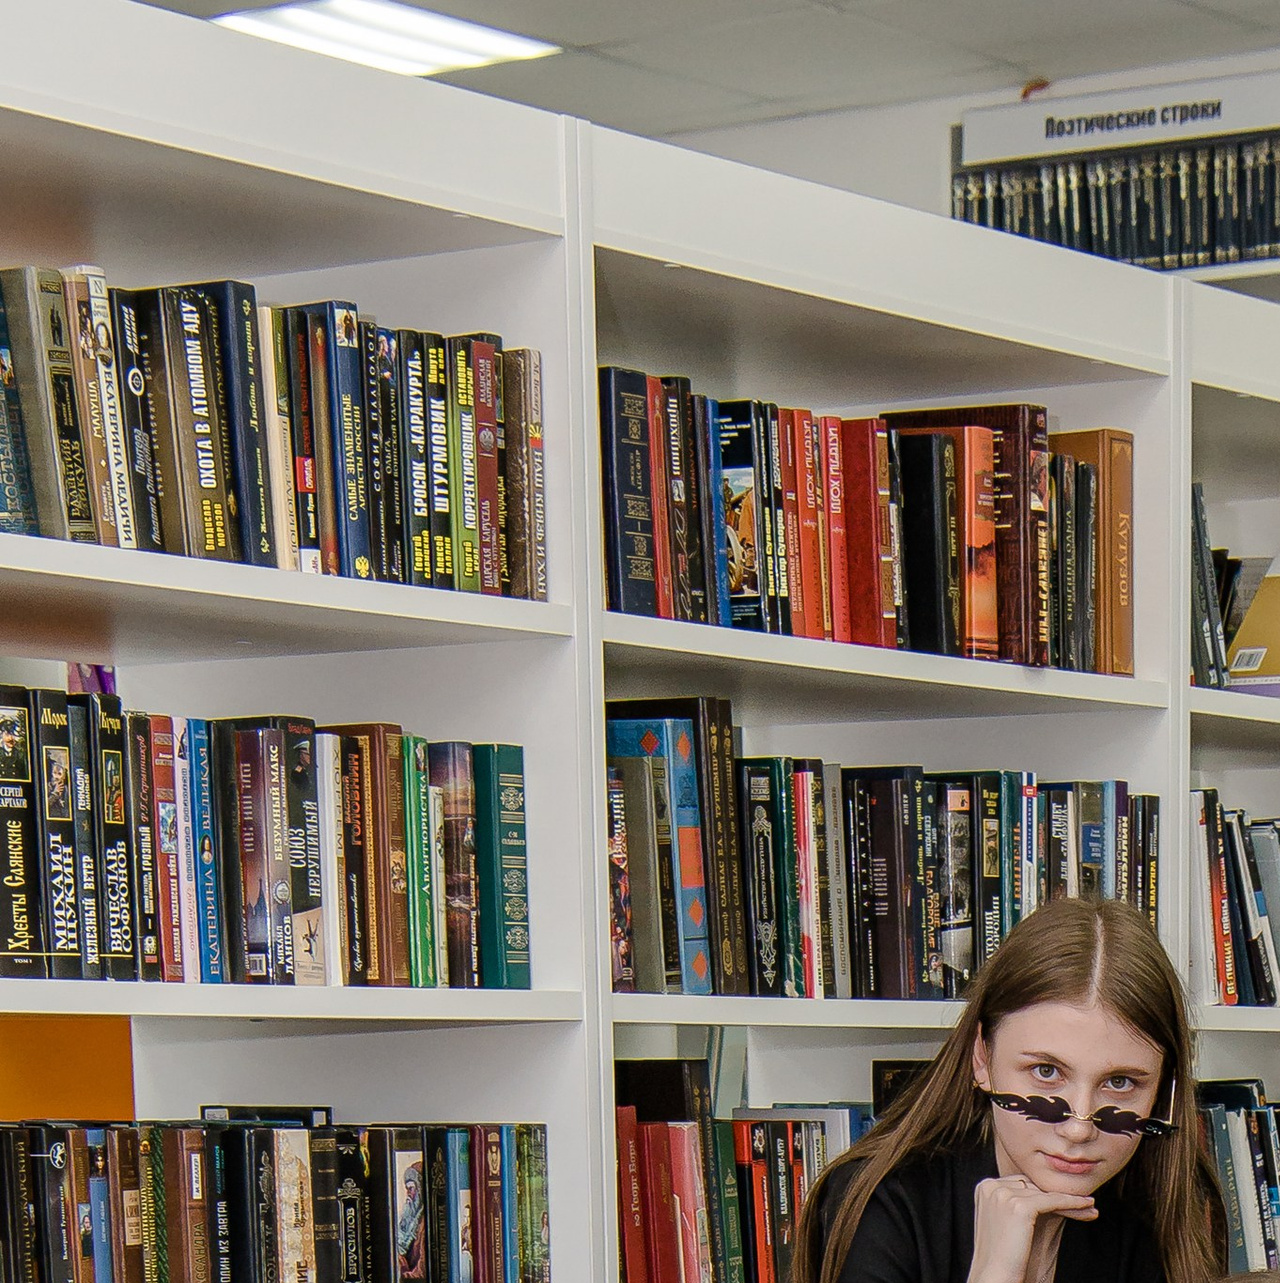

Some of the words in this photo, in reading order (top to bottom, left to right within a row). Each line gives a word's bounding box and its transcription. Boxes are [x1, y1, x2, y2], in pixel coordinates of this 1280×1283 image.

[1045, 107, 1156, 139] Поэтические
[1160, 100, 1222, 125] строки
[181, 301, 200, 334] АДУ
[186, 338, 210, 417] АТОМНОМ
[427, 347, 438, 384] Минута
[456, 349, 468, 406] ОСТАНОВИТЬ
[389, 388, 397, 421] УДАЧИ
[407, 350, 427, 453] «КАРАКУРТА»
[132, 428, 146, 476] Пантера
[197, 423, 212, 434] В
[341, 393, 357, 475] ЗНАМЕНИТЫЕ
[353, 405, 363, 452] РОССИИ
[391, 423, 400, 479] ВОИНСКОЙ
[103, 368, 123, 467] ЕКАТЕРИНА
[116, 471, 133, 541] МЕДИЧИ
[197, 439, 218, 489] ОХОТА
[370, 431, 382, 492] СОФИЯ
[430, 398, 451, 513] ШТУРМОВИК
[460, 412, 477, 530] КОРРЕКТИРОВЩИК
[533, 449, 544, 488] НАШ
[347, 478, 360, 521] САМЫЕ
[355, 456, 367, 510] АРТИСТЫ
[411, 461, 430, 517] БРОСОК
[202, 500, 215, 551] Владислав
[214, 502, 226, 548] МОРОЗОВ
[480, 500, 492, 542] КАРУСЕЛЬ
[534, 491, 545, 541] КНЯЗЬ
[413, 535, 424, 573] Георгий
[434, 534, 445, 575] Алексей
[462, 541, 475, 578] Георгий
[482, 546, 494, 588] ЦАРСКАЯ
[537, 560, 546, 594] ХАН
[766, 556, 776, 597] Виктор
[779, 557, 789, 598] Виктор
[196, 746, 210, 831] ВЕЛИКАЯ
[268, 744, 280, 784] МАКС
[269, 787, 284, 861] БЕЗУМНЫЙ
[348, 752, 362, 846] ГОЛОВНИН
[4, 819, 26, 887] Саянские
[82, 854, 95, 890] ВЕТЕР
[139, 825, 152, 872] ГРОЗНЫЙ
[288, 827, 307, 868] СОЮЗ
[302, 800, 321, 897] НЕРУШИМЫЙ
[50, 832, 69, 951] МИХАИЛ
[63, 845, 78, 950] ЩУКИН
[105, 848, 123, 953] ВЯЧЕСЛАВ
[116, 840, 133, 952] СОФРОНОВ
[8, 893, 34, 950] Хребты
[80, 898, 100, 964] ЖЕЛЕЗНЫЙ
[203, 868, 221, 975] ЕКАТЕРИНА
[1220, 898, 1231, 936] ТАЙНЫ
[282, 915, 294, 975] ЛАНЦОВ
[1222, 939, 1236, 995] ВЕЛИКИЕ
[217, 1200, 229, 1236] ЗАВТРА
[346, 1207, 358, 1276] БРУСИЛОВ
[218, 1239, 230, 1253] ИЗ
